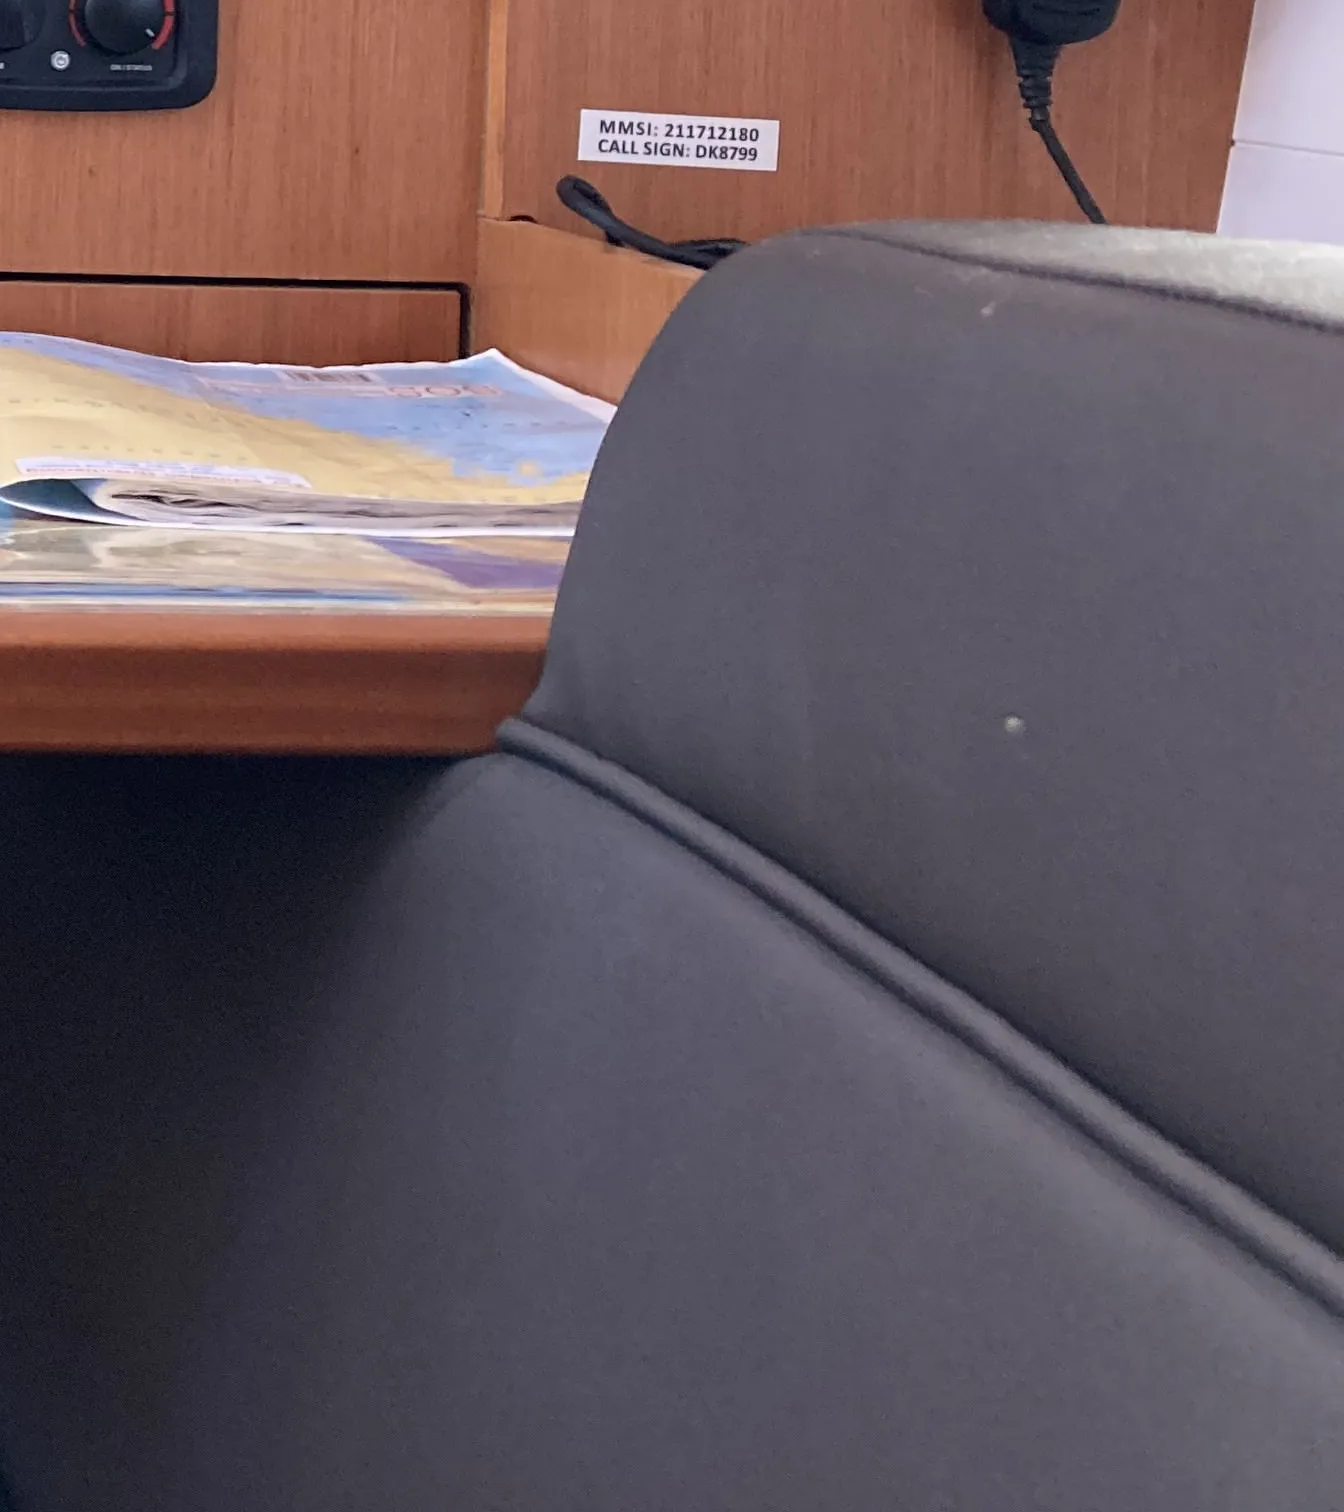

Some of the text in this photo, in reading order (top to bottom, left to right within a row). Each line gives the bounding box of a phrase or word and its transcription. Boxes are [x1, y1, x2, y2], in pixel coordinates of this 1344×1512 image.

[599, 119, 760, 142] MMSI: 211712180
[598, 139, 758, 162] CALL SIGN: DK8799
